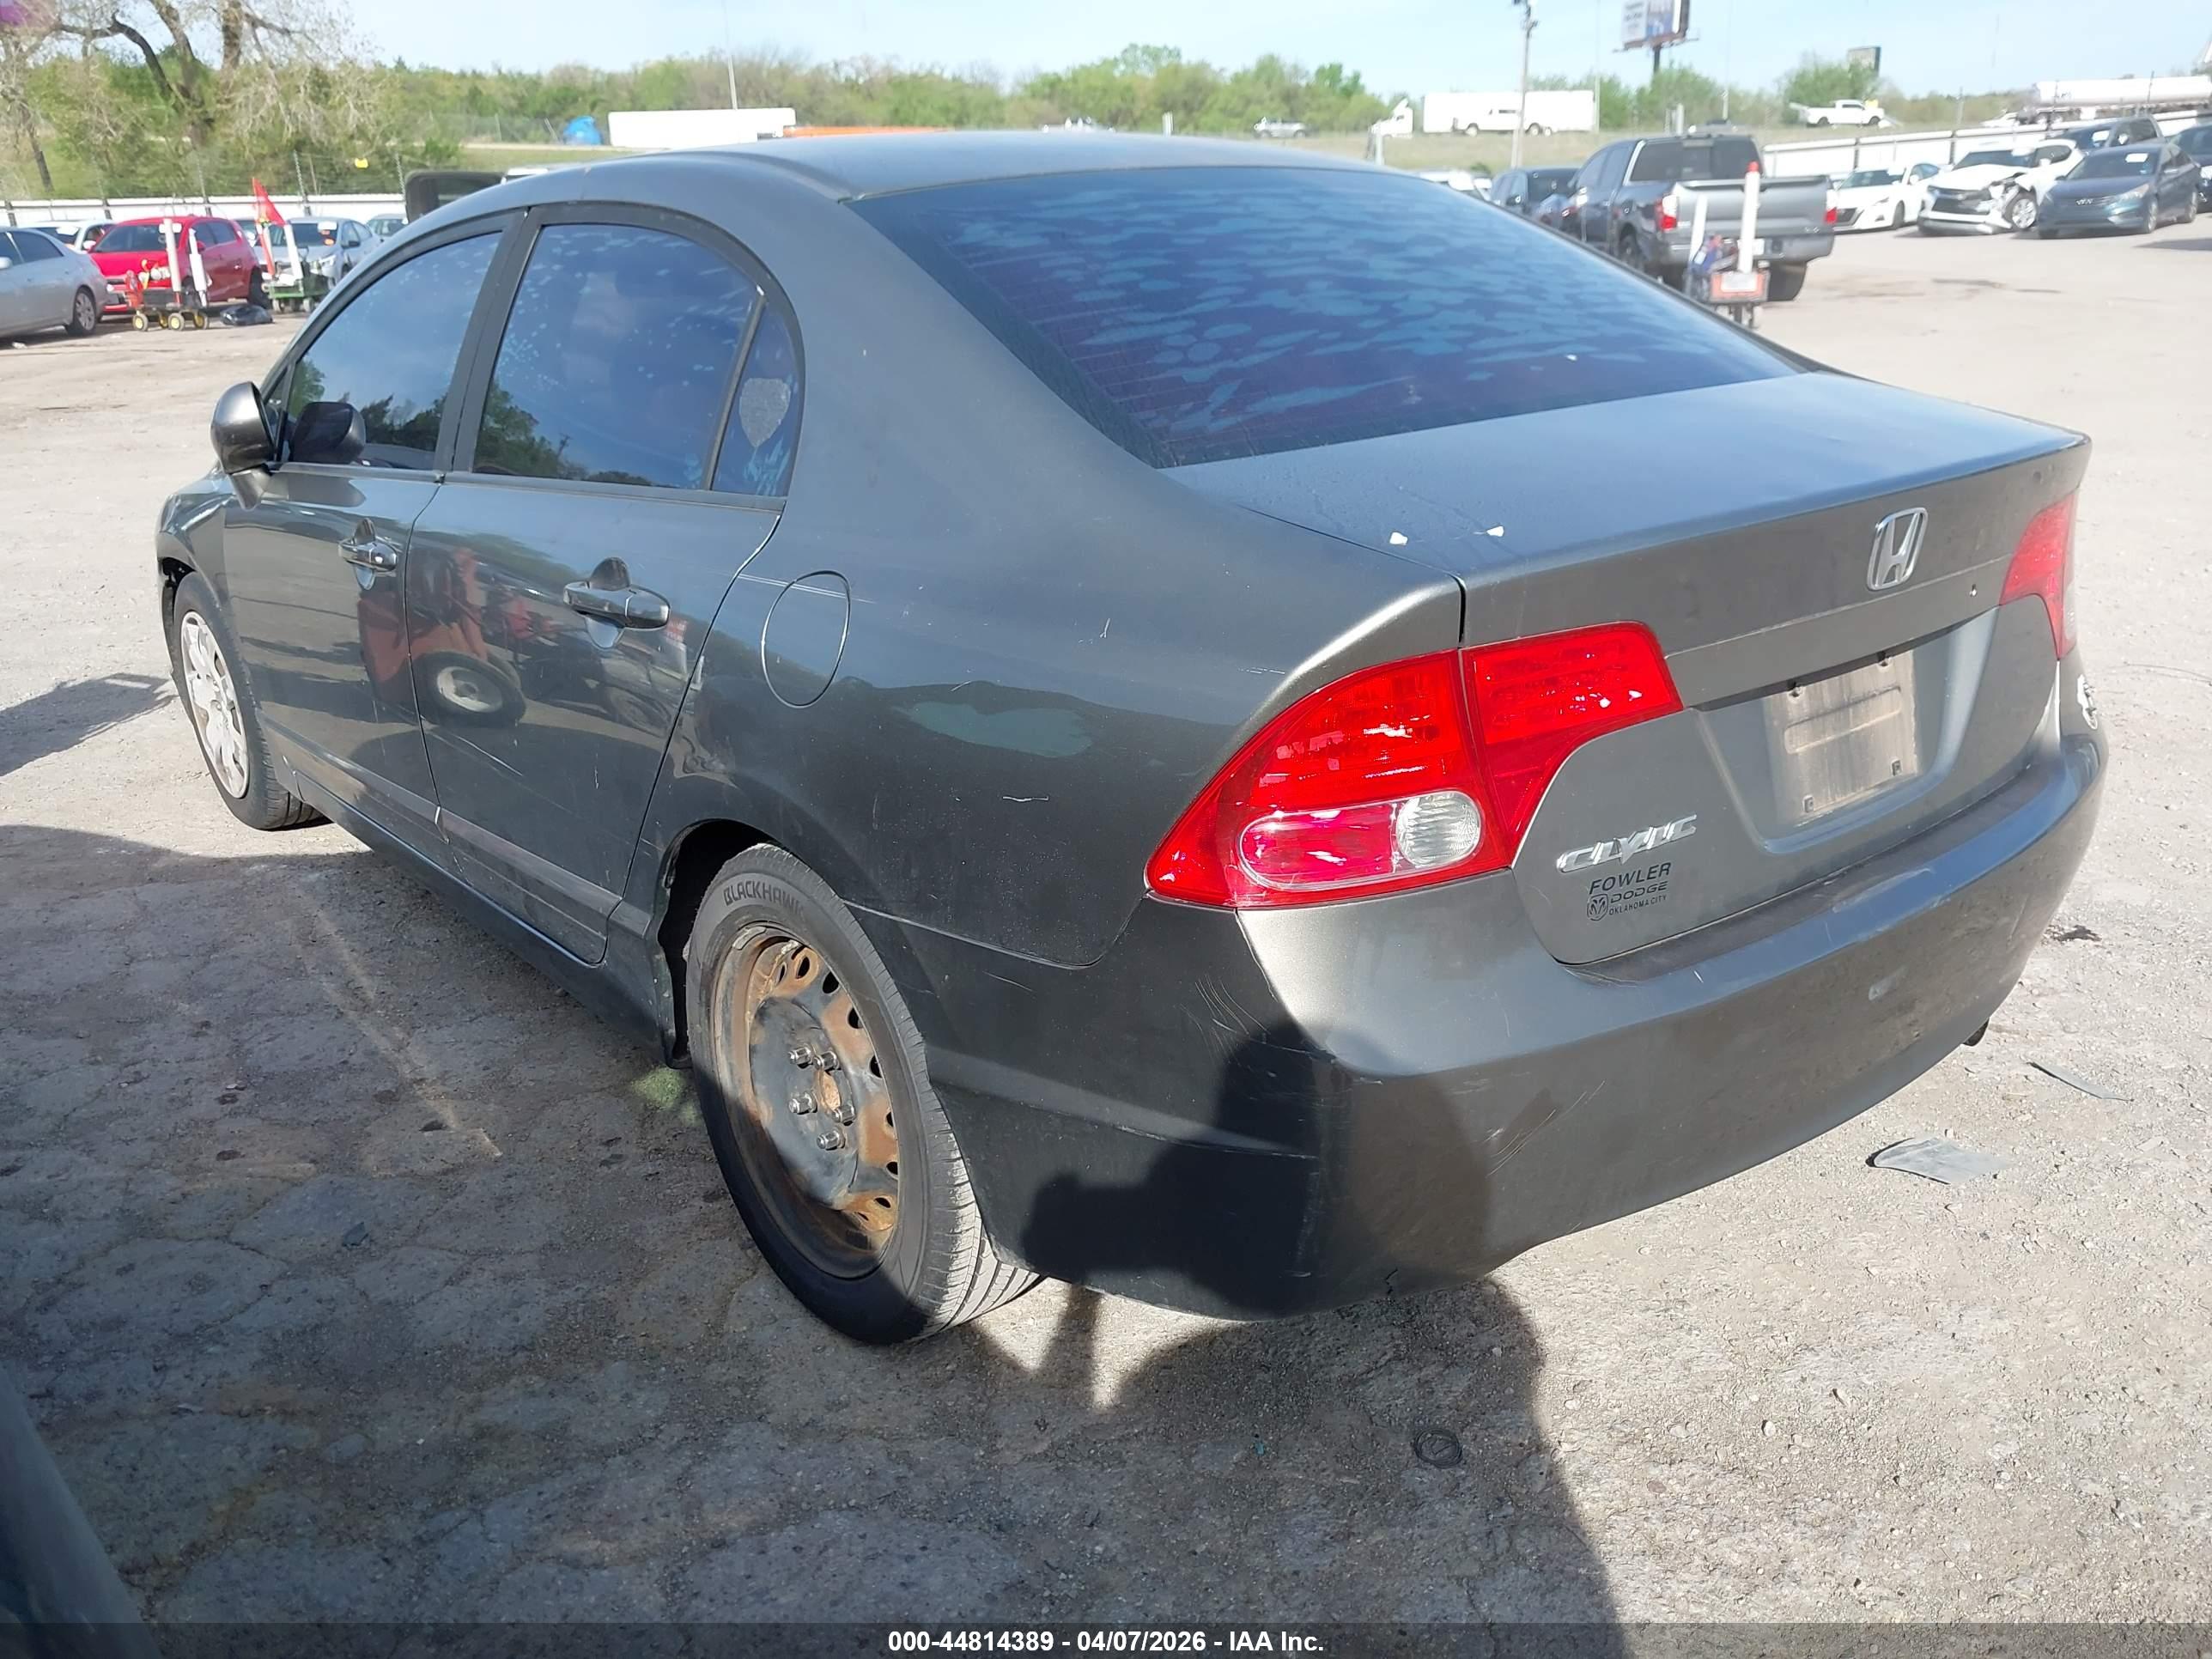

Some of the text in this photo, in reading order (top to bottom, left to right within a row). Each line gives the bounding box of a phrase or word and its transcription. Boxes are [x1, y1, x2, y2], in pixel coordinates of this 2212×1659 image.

[1556, 814, 1698, 873] CIVIC
[1589, 862, 1672, 895] FOWLER
[1609, 881, 1668, 904] DODGE
[1608, 895, 1668, 916] OKLAHOMA CITY
